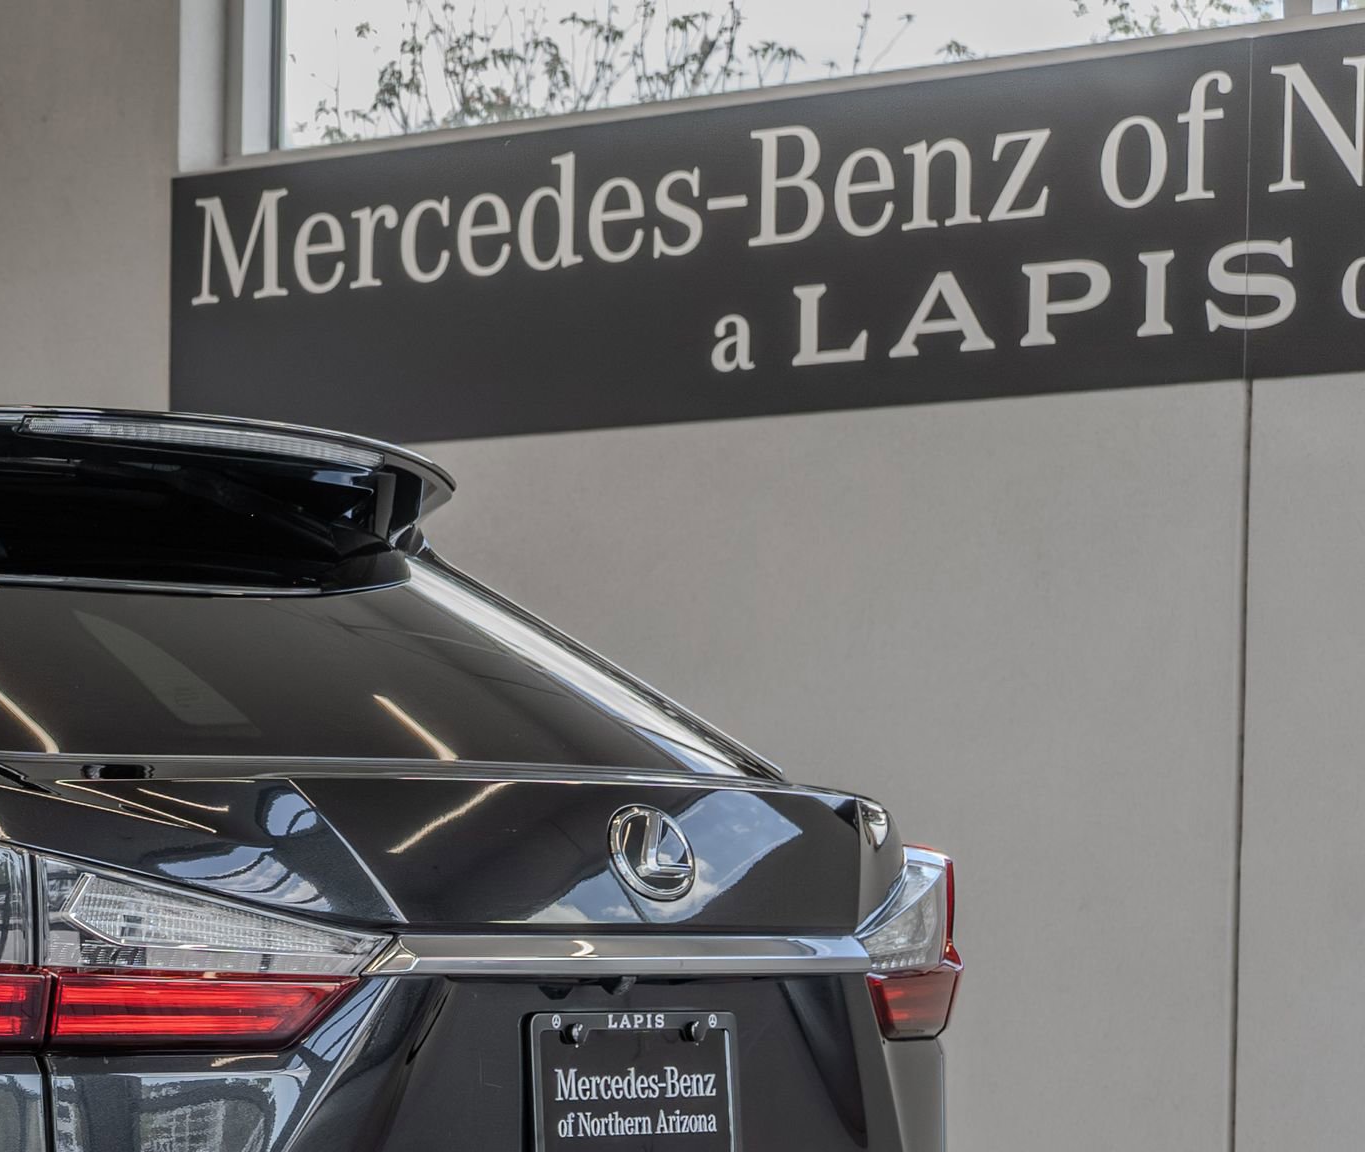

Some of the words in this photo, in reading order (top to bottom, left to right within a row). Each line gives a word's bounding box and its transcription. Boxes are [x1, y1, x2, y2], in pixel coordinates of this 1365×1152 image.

[191, 125, 1051, 307] Mercedes-Benz
[1100, 69, 1232, 210] of
[710, 313, 756, 373] a
[791, 238, 1296, 368] LAPIS
[607, 1013, 666, 1029] LAPIS
[554, 1066, 717, 1101] Mercedes-Benz
[557, 1112, 576, 1138] of
[577, 1110, 653, 1137] Northern
[655, 1109, 717, 1135] Arizona
